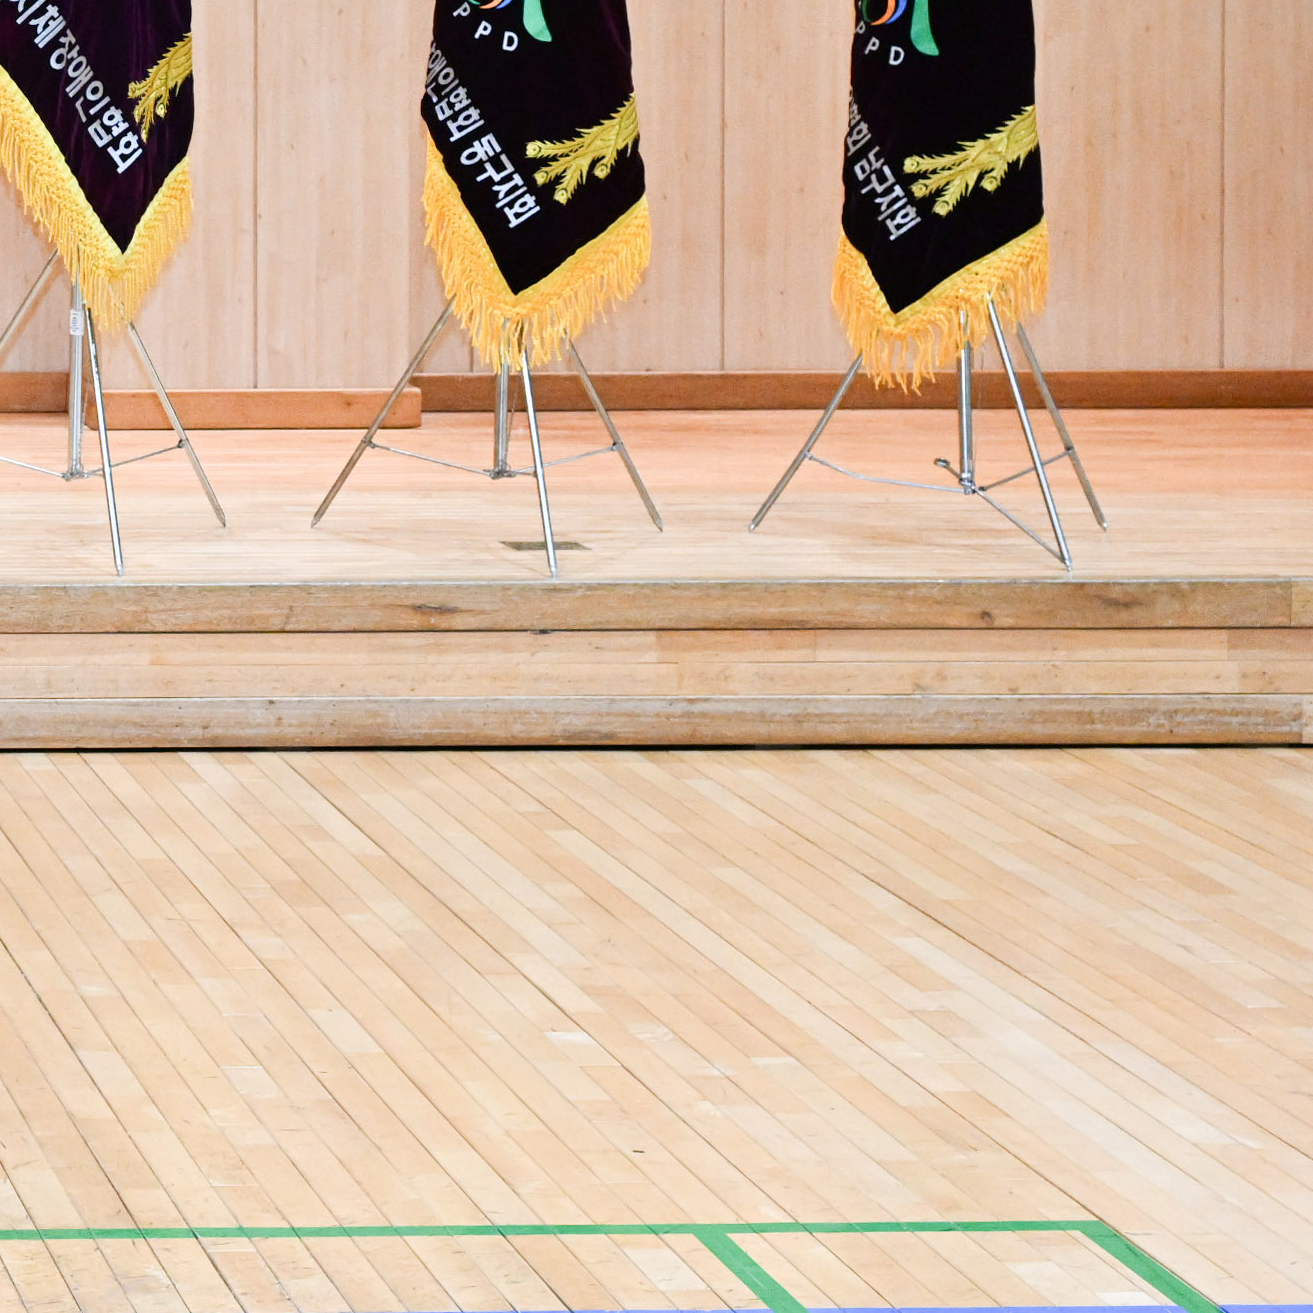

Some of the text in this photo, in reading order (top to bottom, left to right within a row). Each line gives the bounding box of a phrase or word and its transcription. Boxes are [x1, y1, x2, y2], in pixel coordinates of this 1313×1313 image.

[425, 41, 542, 229] 애인협회 동구지회
[853, 145, 923, 242] 남구지회
